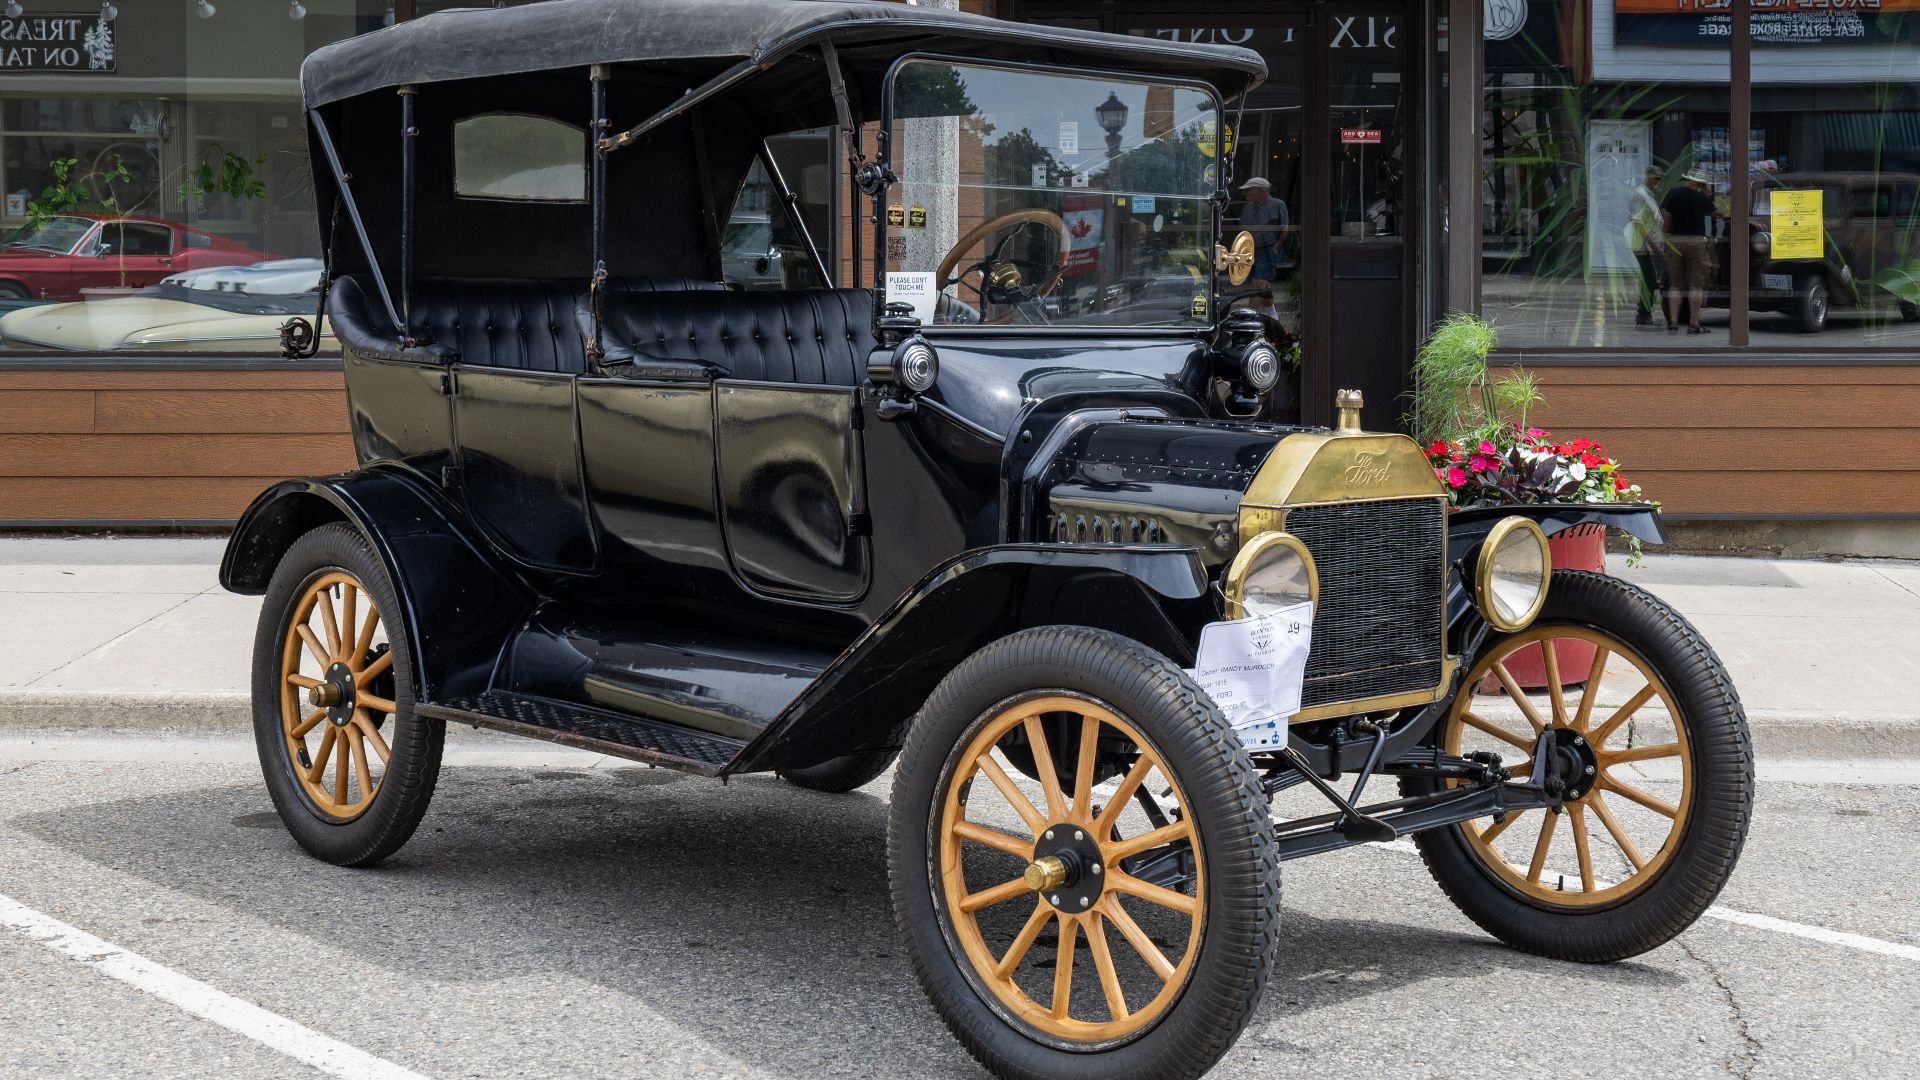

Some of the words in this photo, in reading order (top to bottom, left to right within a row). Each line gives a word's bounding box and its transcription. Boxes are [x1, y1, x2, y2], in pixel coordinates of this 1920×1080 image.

[889, 276, 911, 284] PLEASE
[1344, 450, 1391, 485] Ford
[1220, 665, 1243, 673] RANDY
[1216, 690, 1233, 699] FORD
